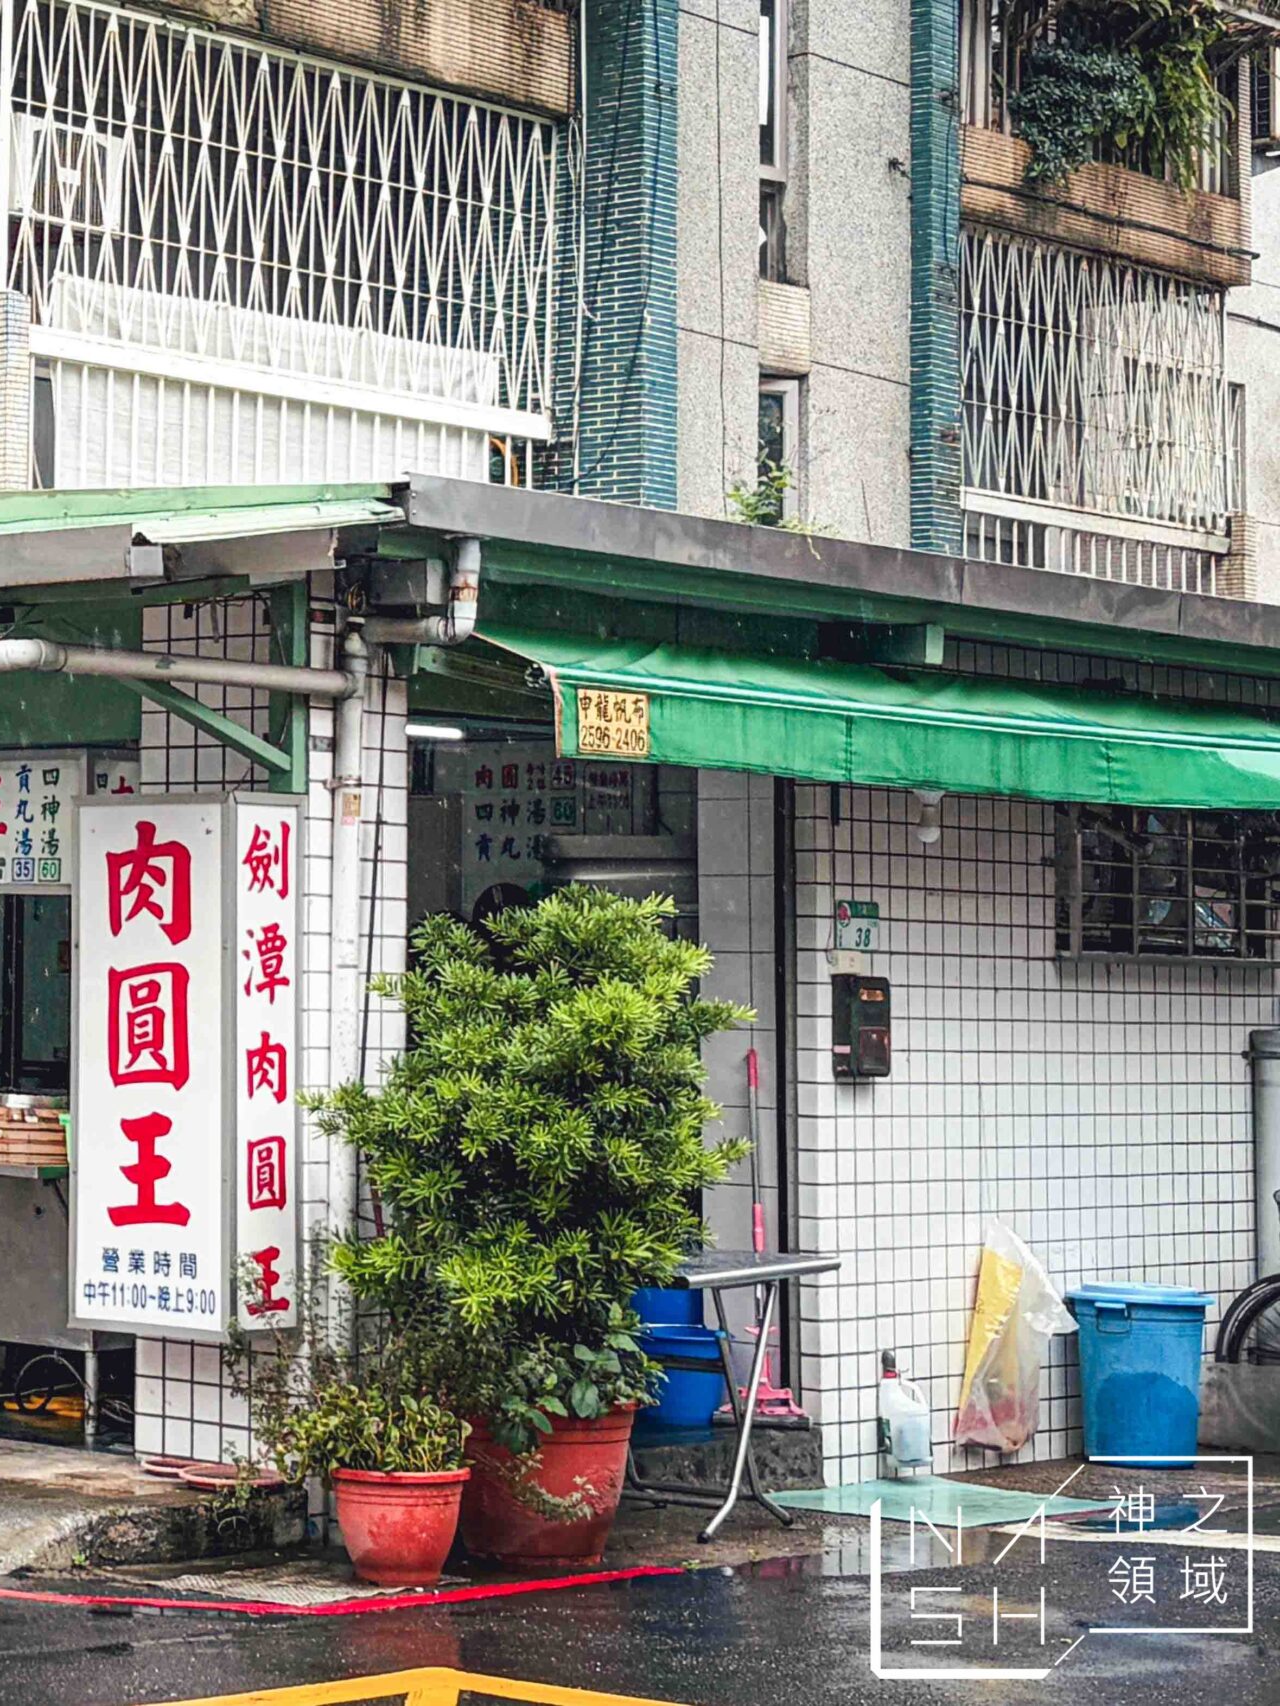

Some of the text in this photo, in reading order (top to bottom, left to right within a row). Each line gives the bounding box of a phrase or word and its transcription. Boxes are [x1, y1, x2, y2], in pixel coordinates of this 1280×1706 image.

[14, 763, 34, 856] 貢丸湯
[40, 767, 60, 856] 四神湯
[15, 860, 31, 878] 35
[855, 927, 871, 948] 38
[105, 820, 192, 1228] 肉圓王
[242, 820, 290, 1316] 劍潭肉圓王
[102, 1247, 198, 1280] 營業時間
